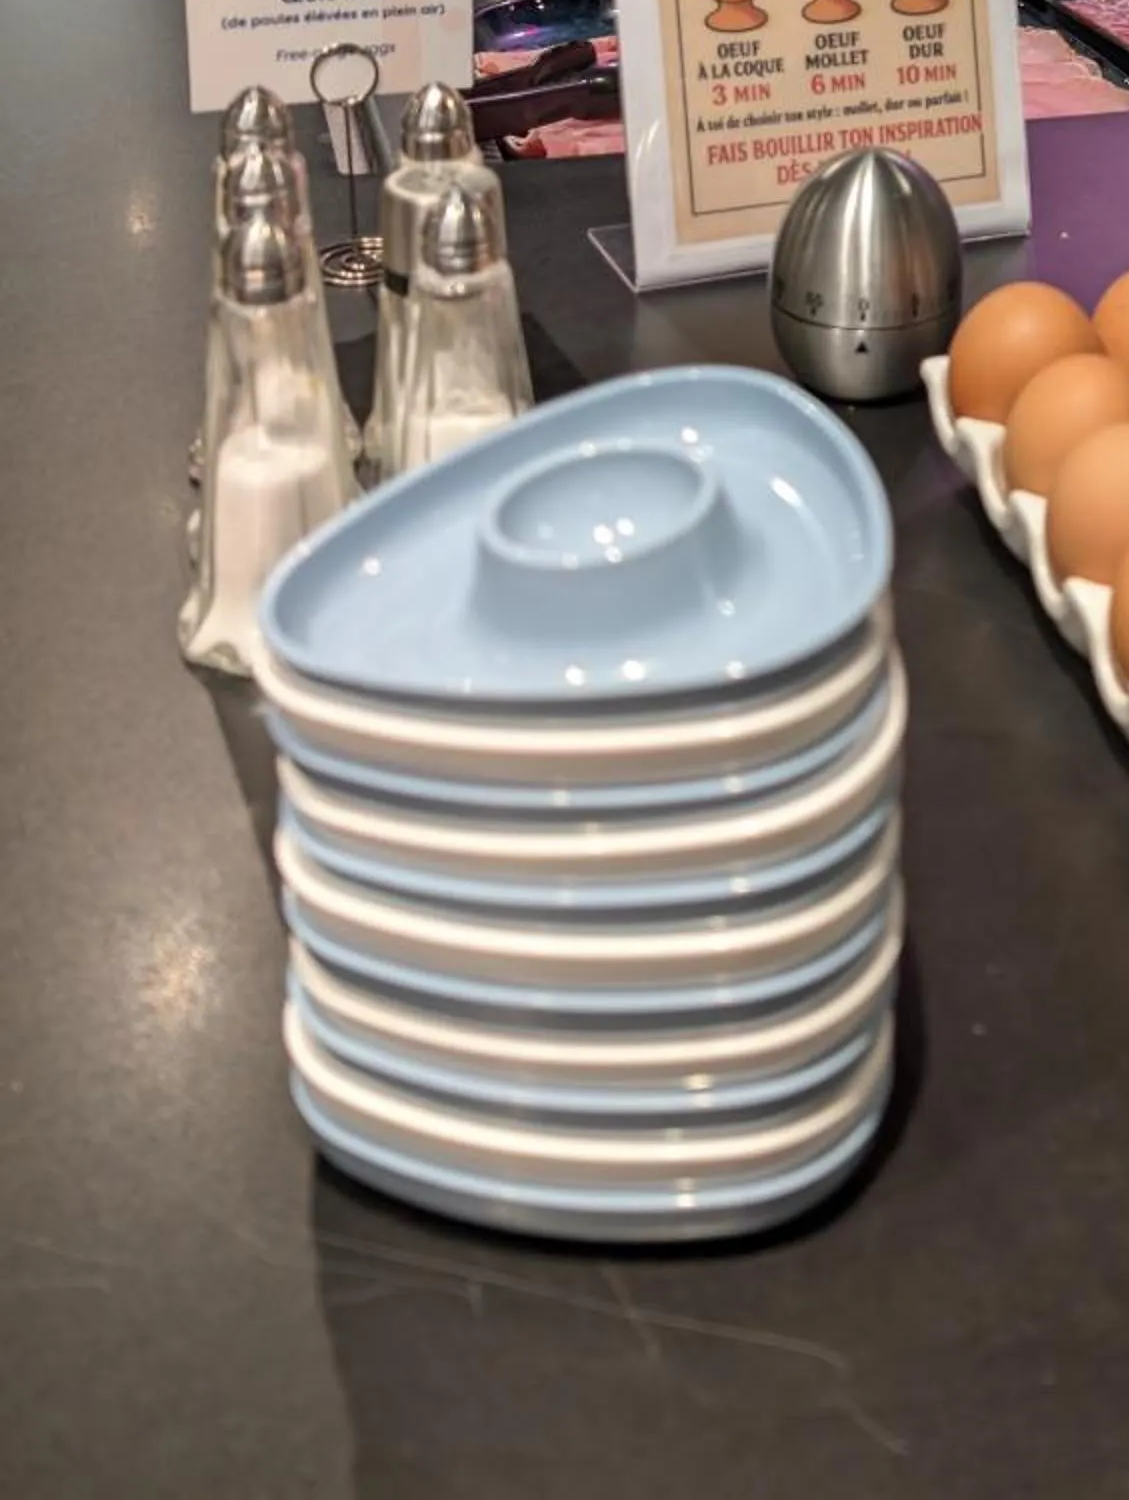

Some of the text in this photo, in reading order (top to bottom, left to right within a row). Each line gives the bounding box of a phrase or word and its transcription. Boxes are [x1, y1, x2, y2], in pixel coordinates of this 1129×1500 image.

[250, 13, 300, 30] poules
[361, 8, 379, 20] en
[382, 3, 417, 21] plein
[815, 30, 860, 50] OEUF
[902, 22, 945, 42] OEUF
[717, 40, 760, 59] OEUF
[805, 48, 869, 70] MOLLET
[909, 42, 944, 59] DUR
[711, 62, 731, 79] LA
[733, 58, 784, 77] COQUE
[896, 63, 957, 85] 10 MIN
[712, 82, 771, 106] 3 MIN
[811, 72, 865, 95] 6 MIN
[806, 104, 833, 121] style
[707, 114, 983, 165] FAIS BOUILLIR TON INSPIRATION
